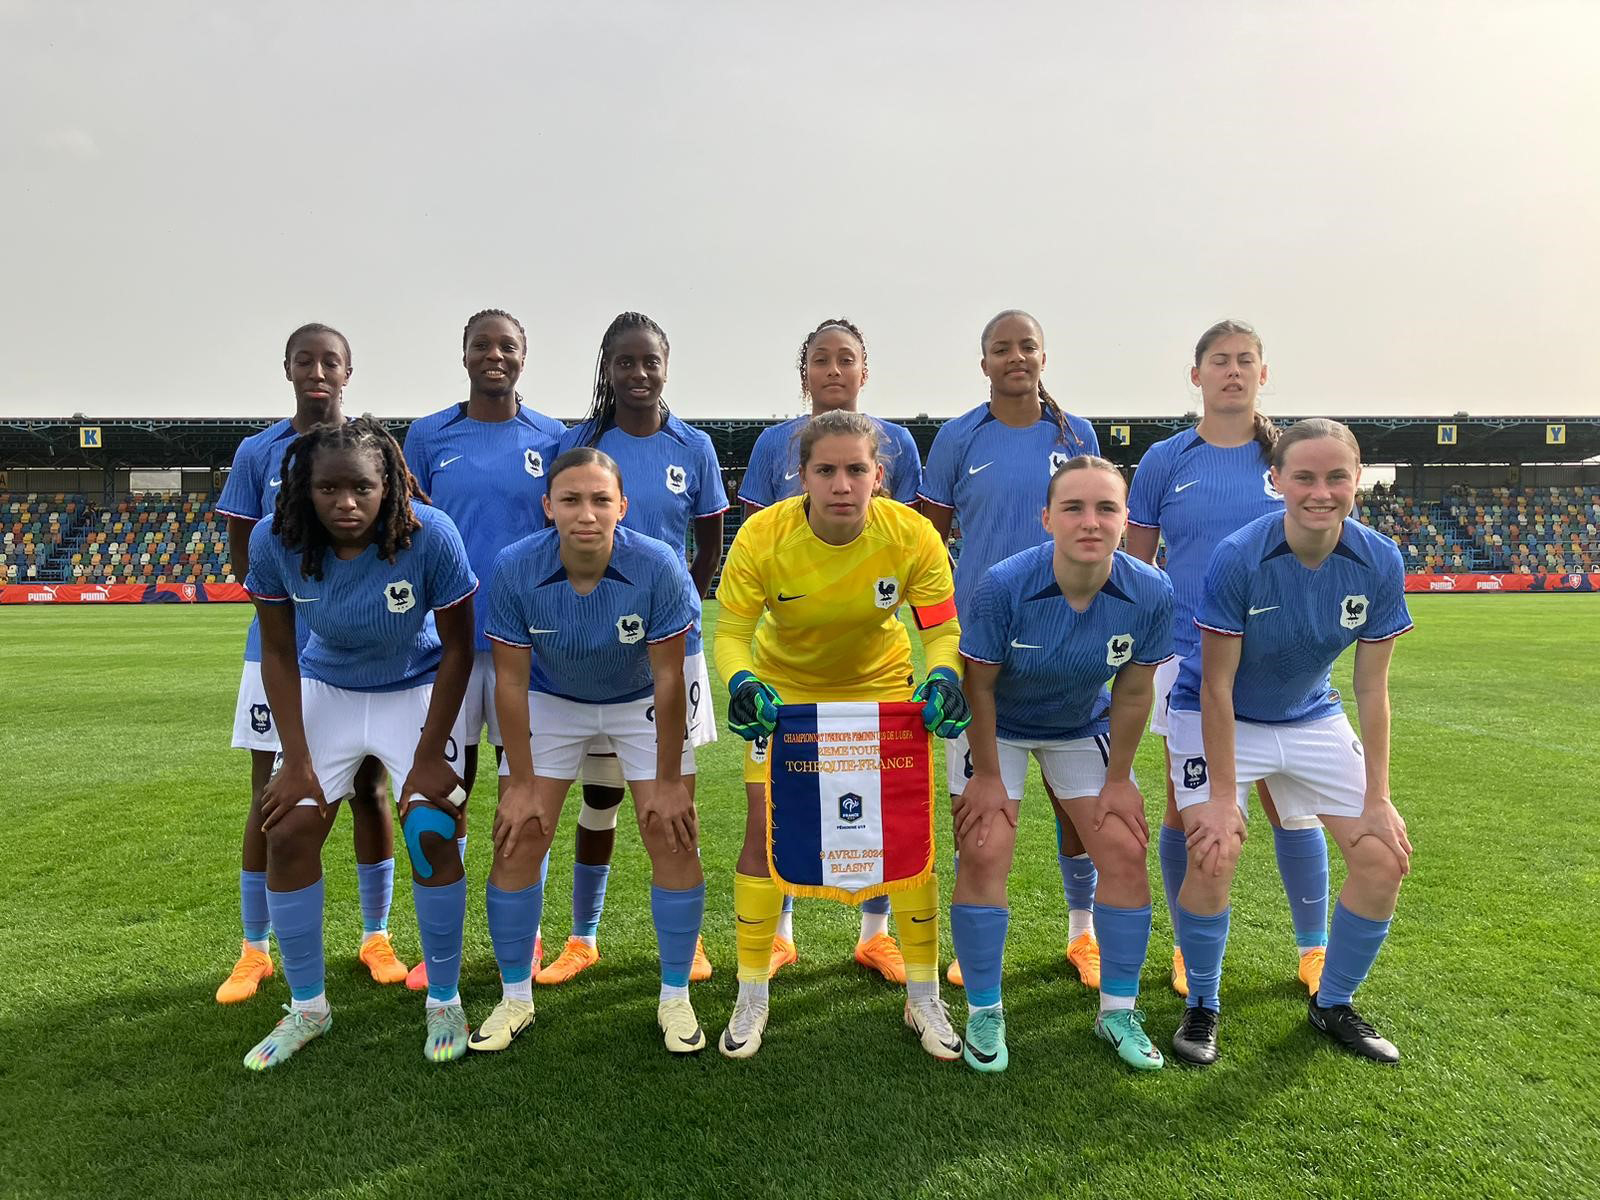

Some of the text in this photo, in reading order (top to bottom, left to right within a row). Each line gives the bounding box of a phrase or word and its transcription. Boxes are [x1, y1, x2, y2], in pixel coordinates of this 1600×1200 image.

[84, 429, 98, 445] K
[1441, 427, 1453, 442] N
[1550, 427, 1562, 442] Y
[689, 681, 701, 719] 9
[850, 745, 881, 756] TOUR
[828, 849, 861, 860] AVRIL
